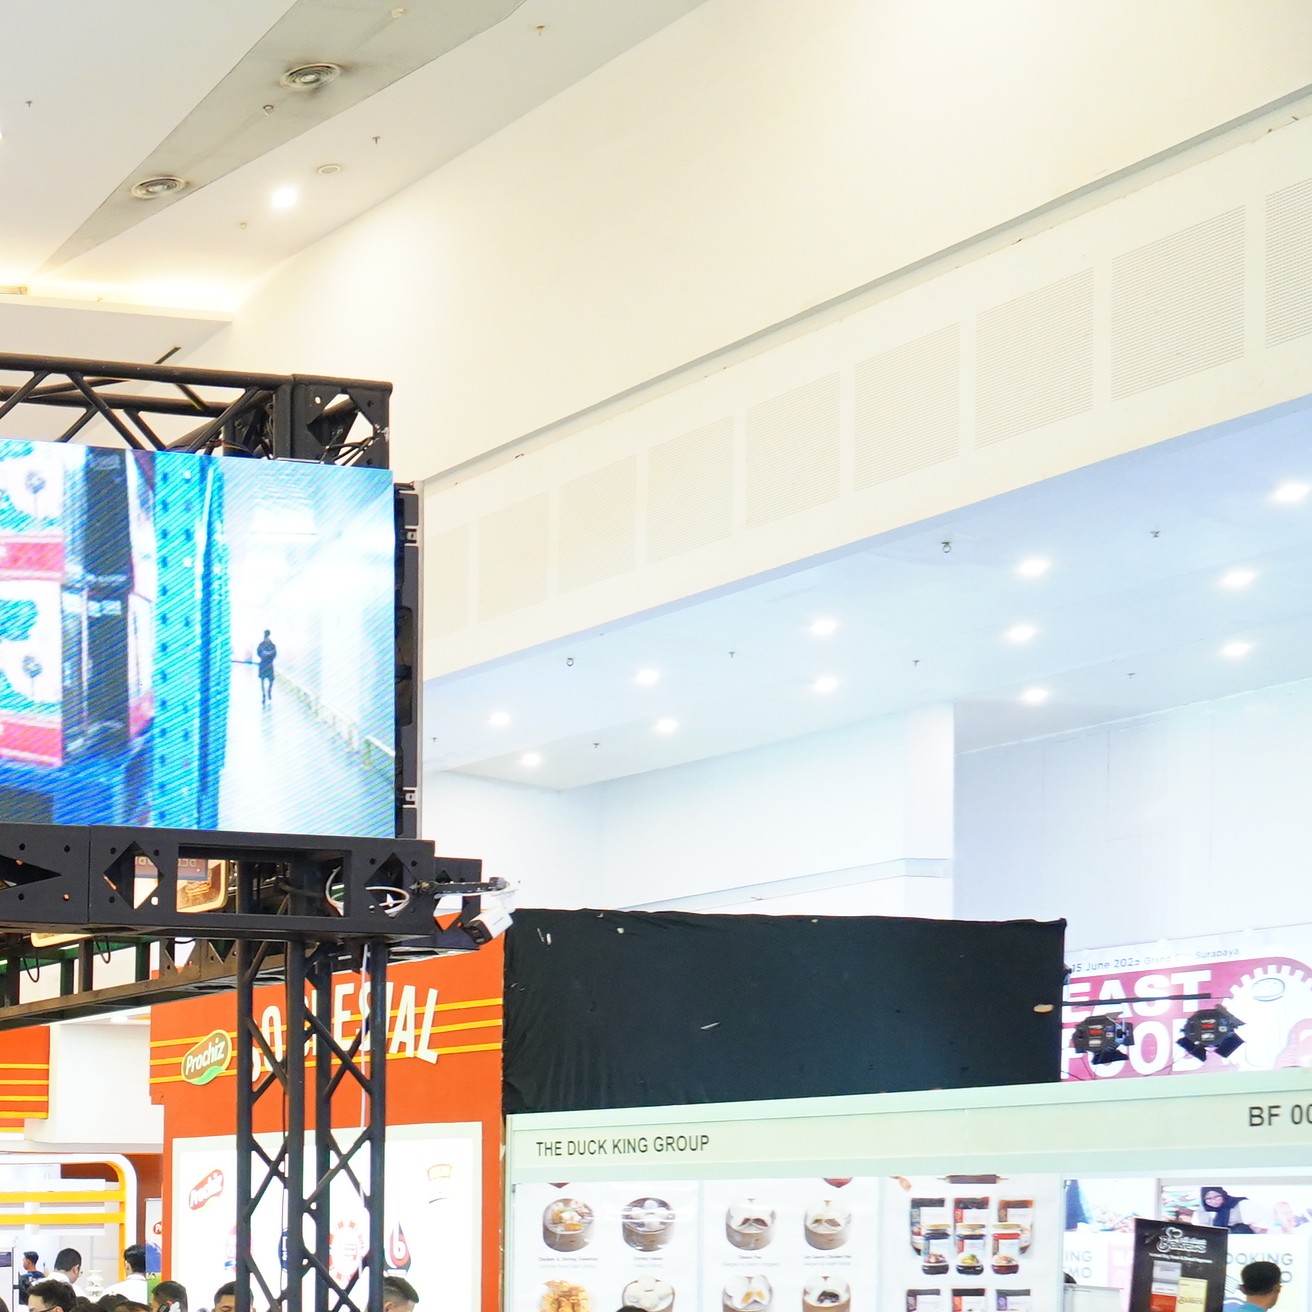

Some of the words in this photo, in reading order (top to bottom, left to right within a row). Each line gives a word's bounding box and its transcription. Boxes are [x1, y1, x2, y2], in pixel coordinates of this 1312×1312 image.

[1063, 970, 1212, 1023] EAST
[185, 1037, 225, 1076] Prochiz
[1248, 1106, 1282, 1127] BF
[536, 1140, 563, 1157] THE
[567, 1138, 608, 1156] DUCK
[612, 1136, 649, 1155] KING
[653, 1134, 710, 1152] GROUP
